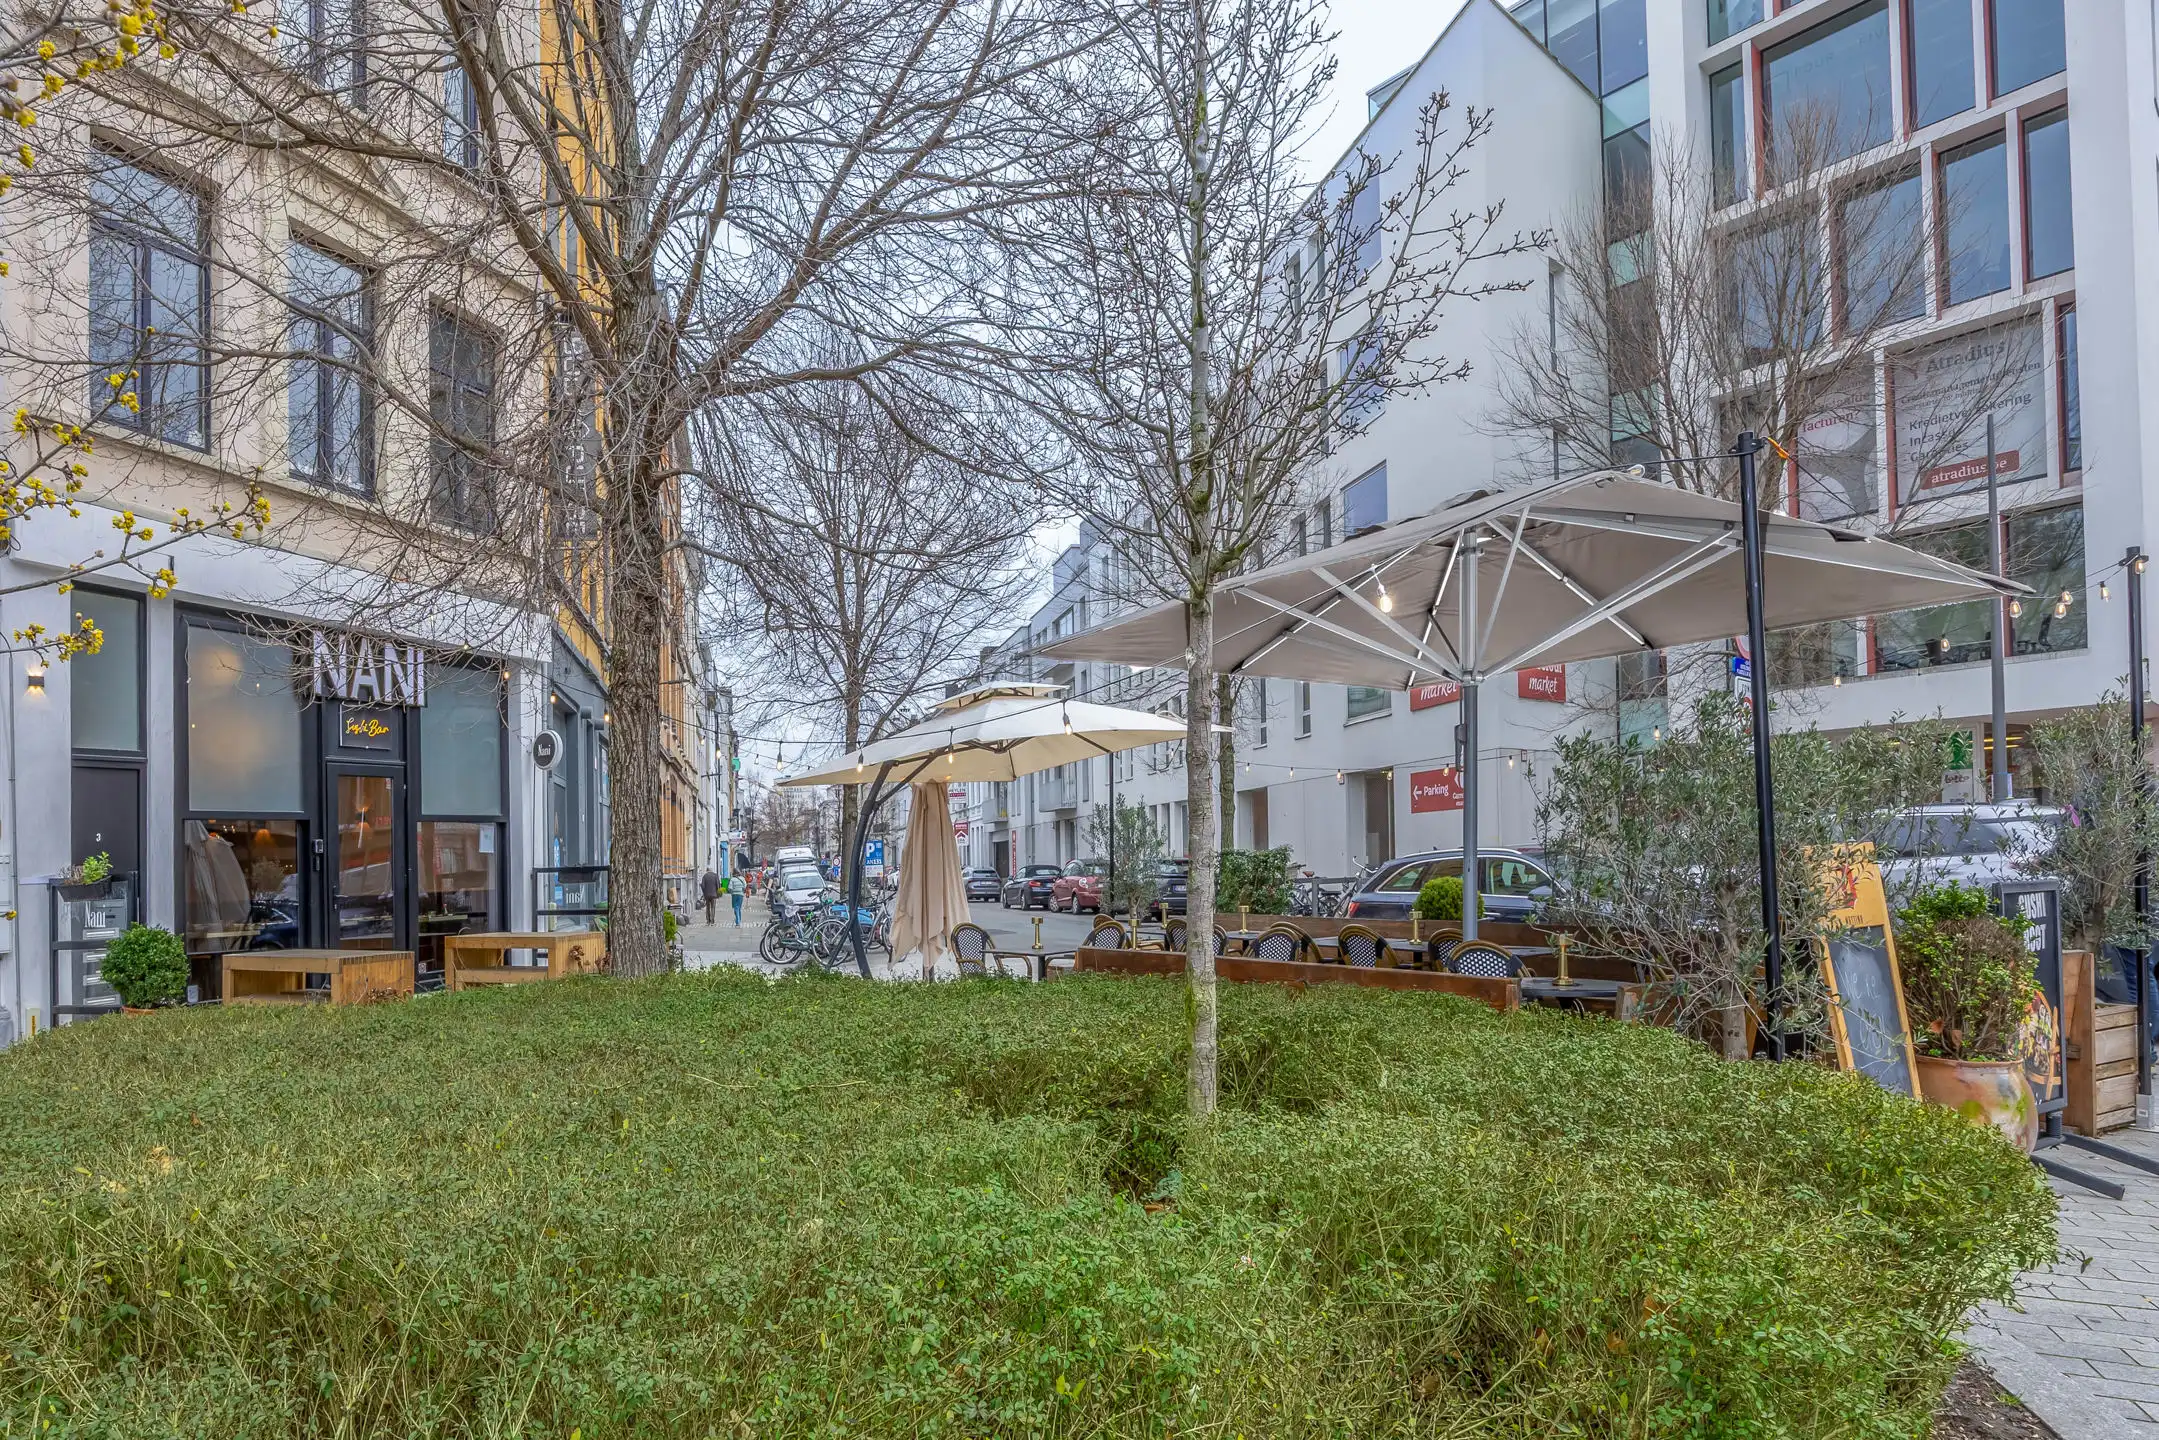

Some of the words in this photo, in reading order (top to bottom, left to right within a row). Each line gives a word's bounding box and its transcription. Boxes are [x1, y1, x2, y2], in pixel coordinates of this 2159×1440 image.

[1926, 341, 2005, 373] Atradius
[1931, 459, 2008, 484] atradiuse
[313, 630, 424, 706] NANI
[1420, 682, 1457, 701] market
[1529, 675, 1558, 694] market
[368, 719, 389, 737] Bar
[538, 744, 551, 757] Nani
[1423, 784, 1449, 798] Parking
[95, 832, 101, 842] 3
[866, 842, 875, 858] P
[84, 901, 106, 928] Nani
[2018, 892, 2047, 920] SUSHI
